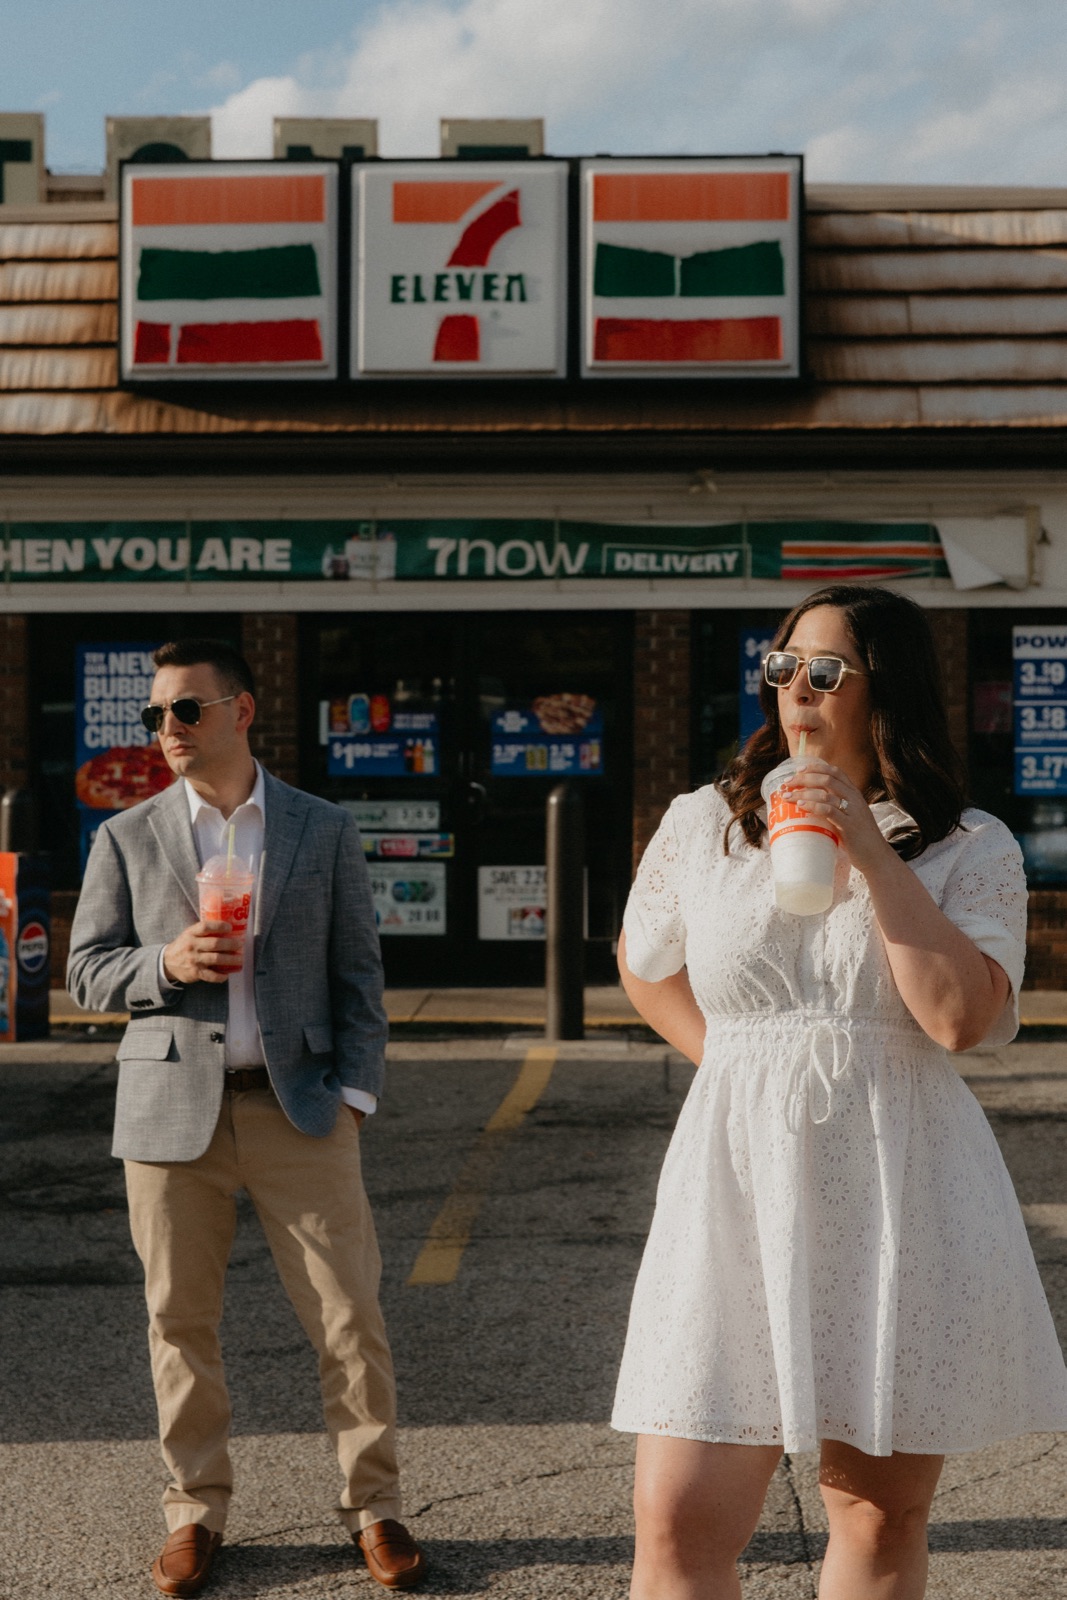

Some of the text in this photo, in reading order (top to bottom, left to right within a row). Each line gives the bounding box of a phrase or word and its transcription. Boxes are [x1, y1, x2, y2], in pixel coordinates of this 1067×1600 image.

[91, 537, 190, 572] YOU
[195, 537, 292, 572] ARE
[613, 551, 739, 573] DELIVERY
[83, 723, 157, 749] CRUS
